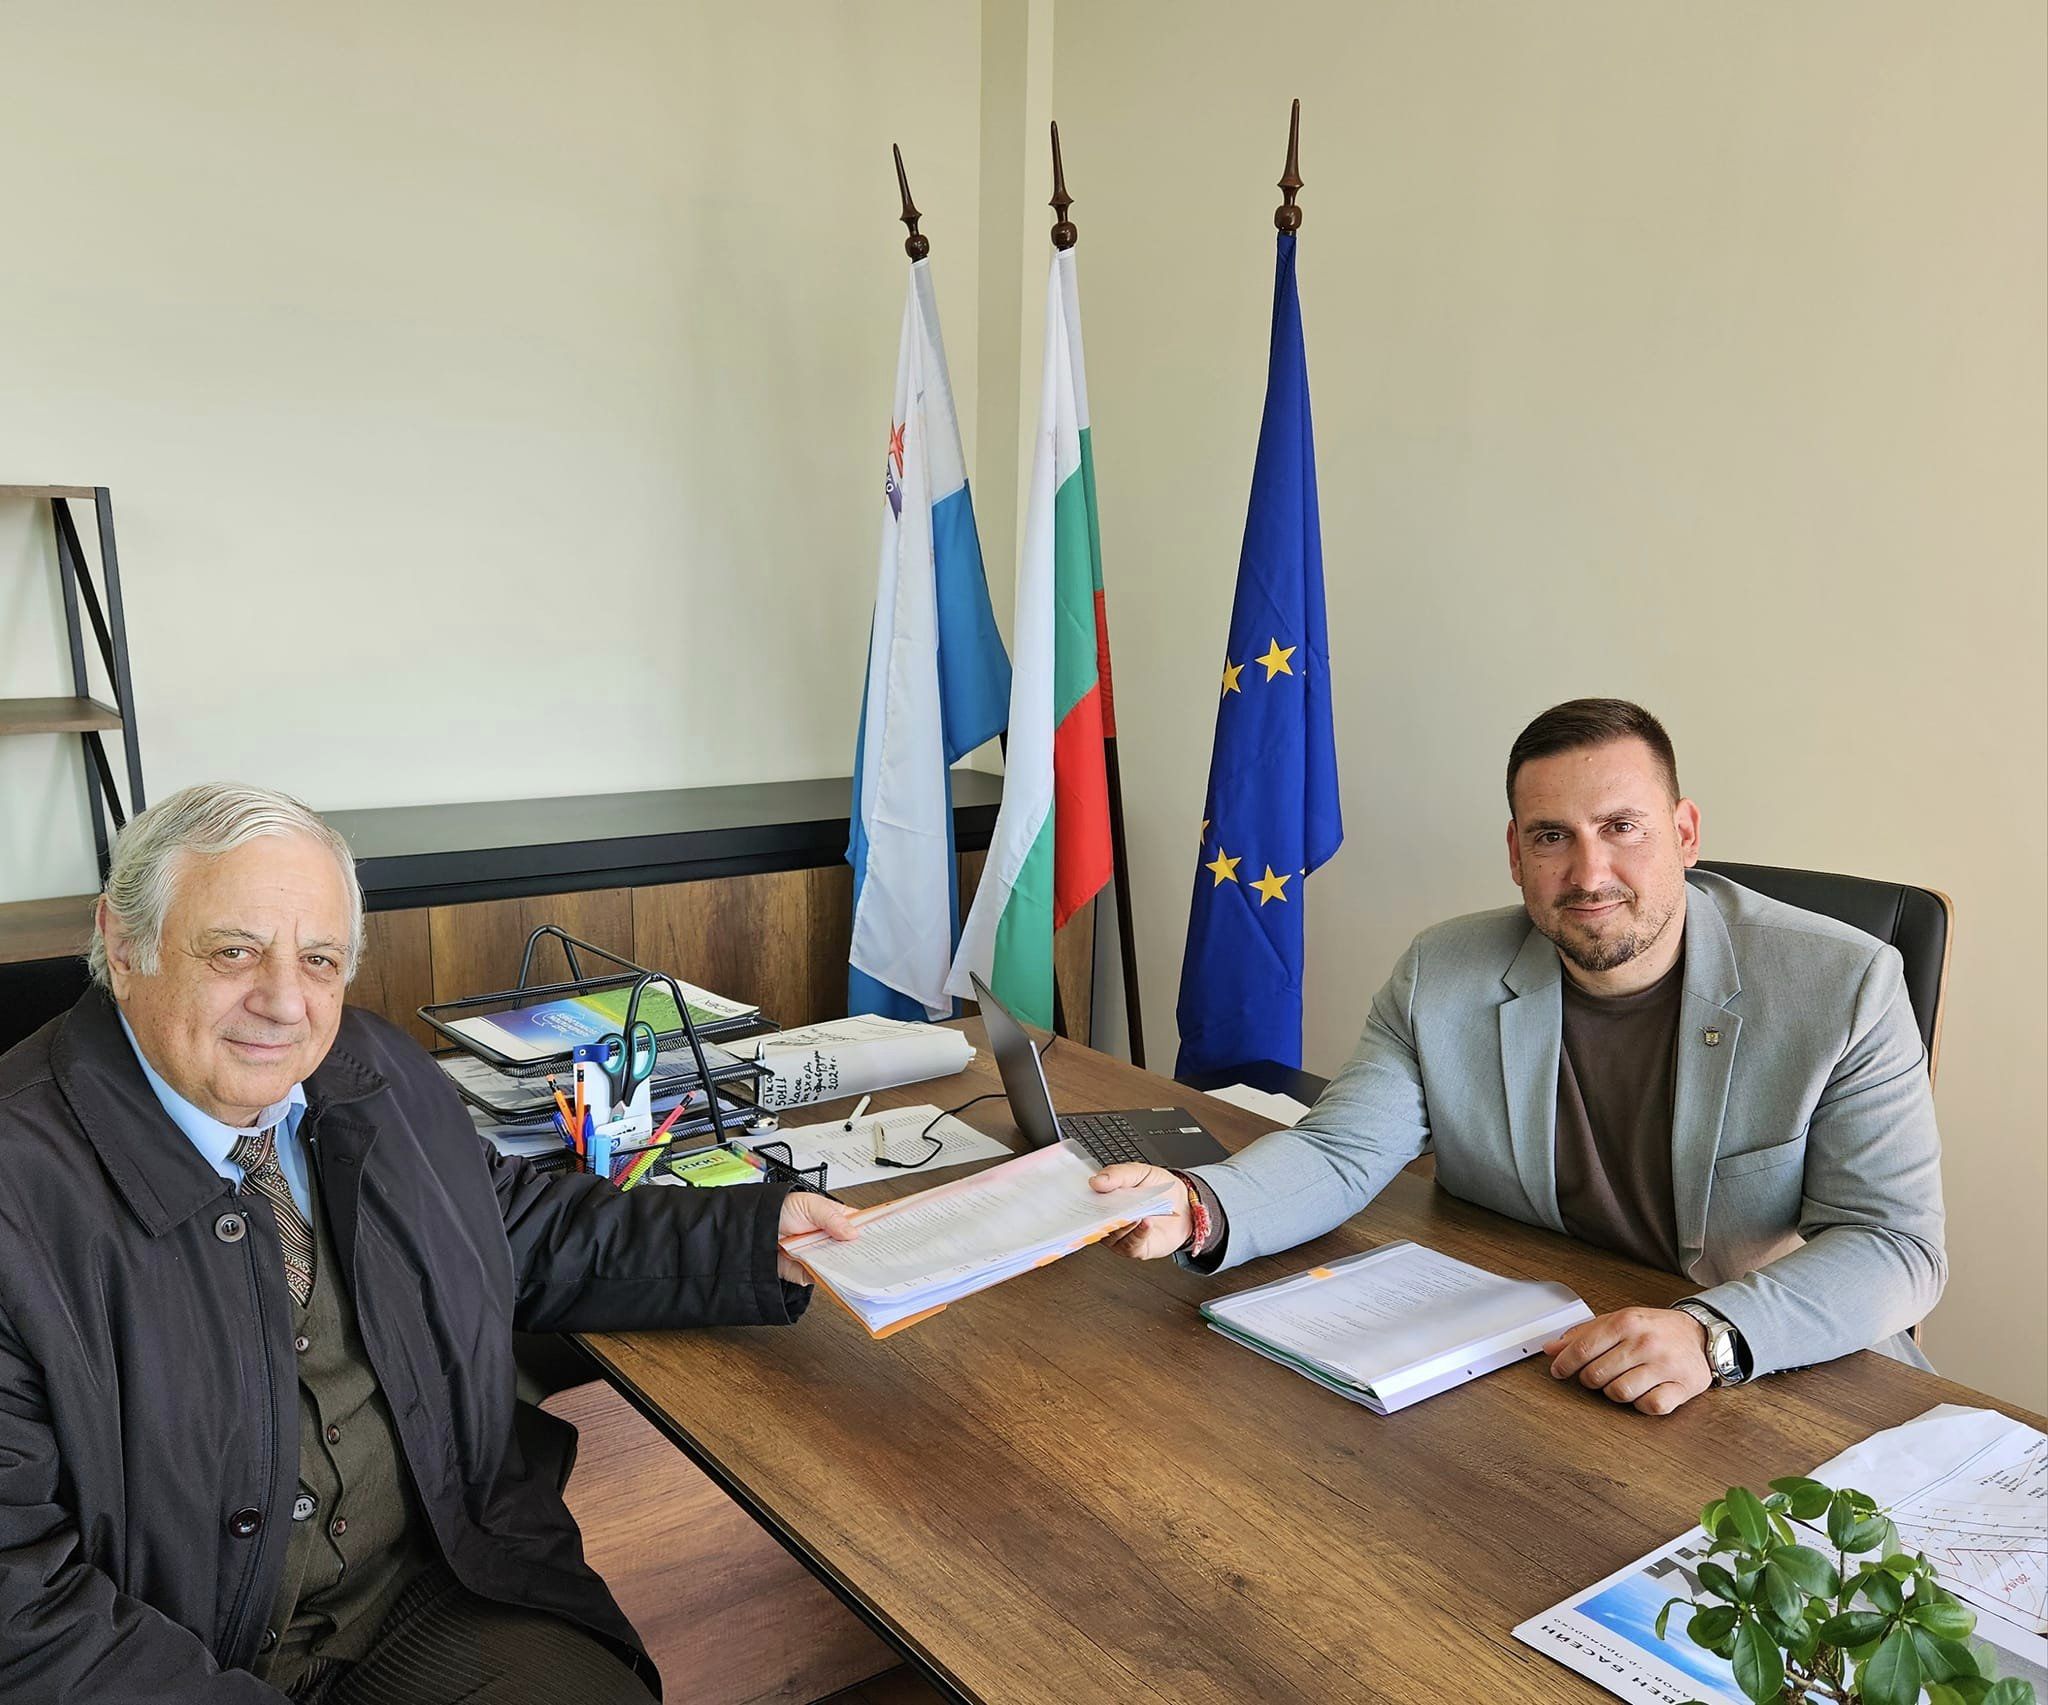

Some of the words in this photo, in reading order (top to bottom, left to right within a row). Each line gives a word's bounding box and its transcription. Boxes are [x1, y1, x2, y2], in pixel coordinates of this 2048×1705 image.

[787, 1077, 803, 1105] Каса
[1541, 1625, 1625, 1674] БАСЕЙН
[1632, 1676, 1676, 1705] ВЕН
